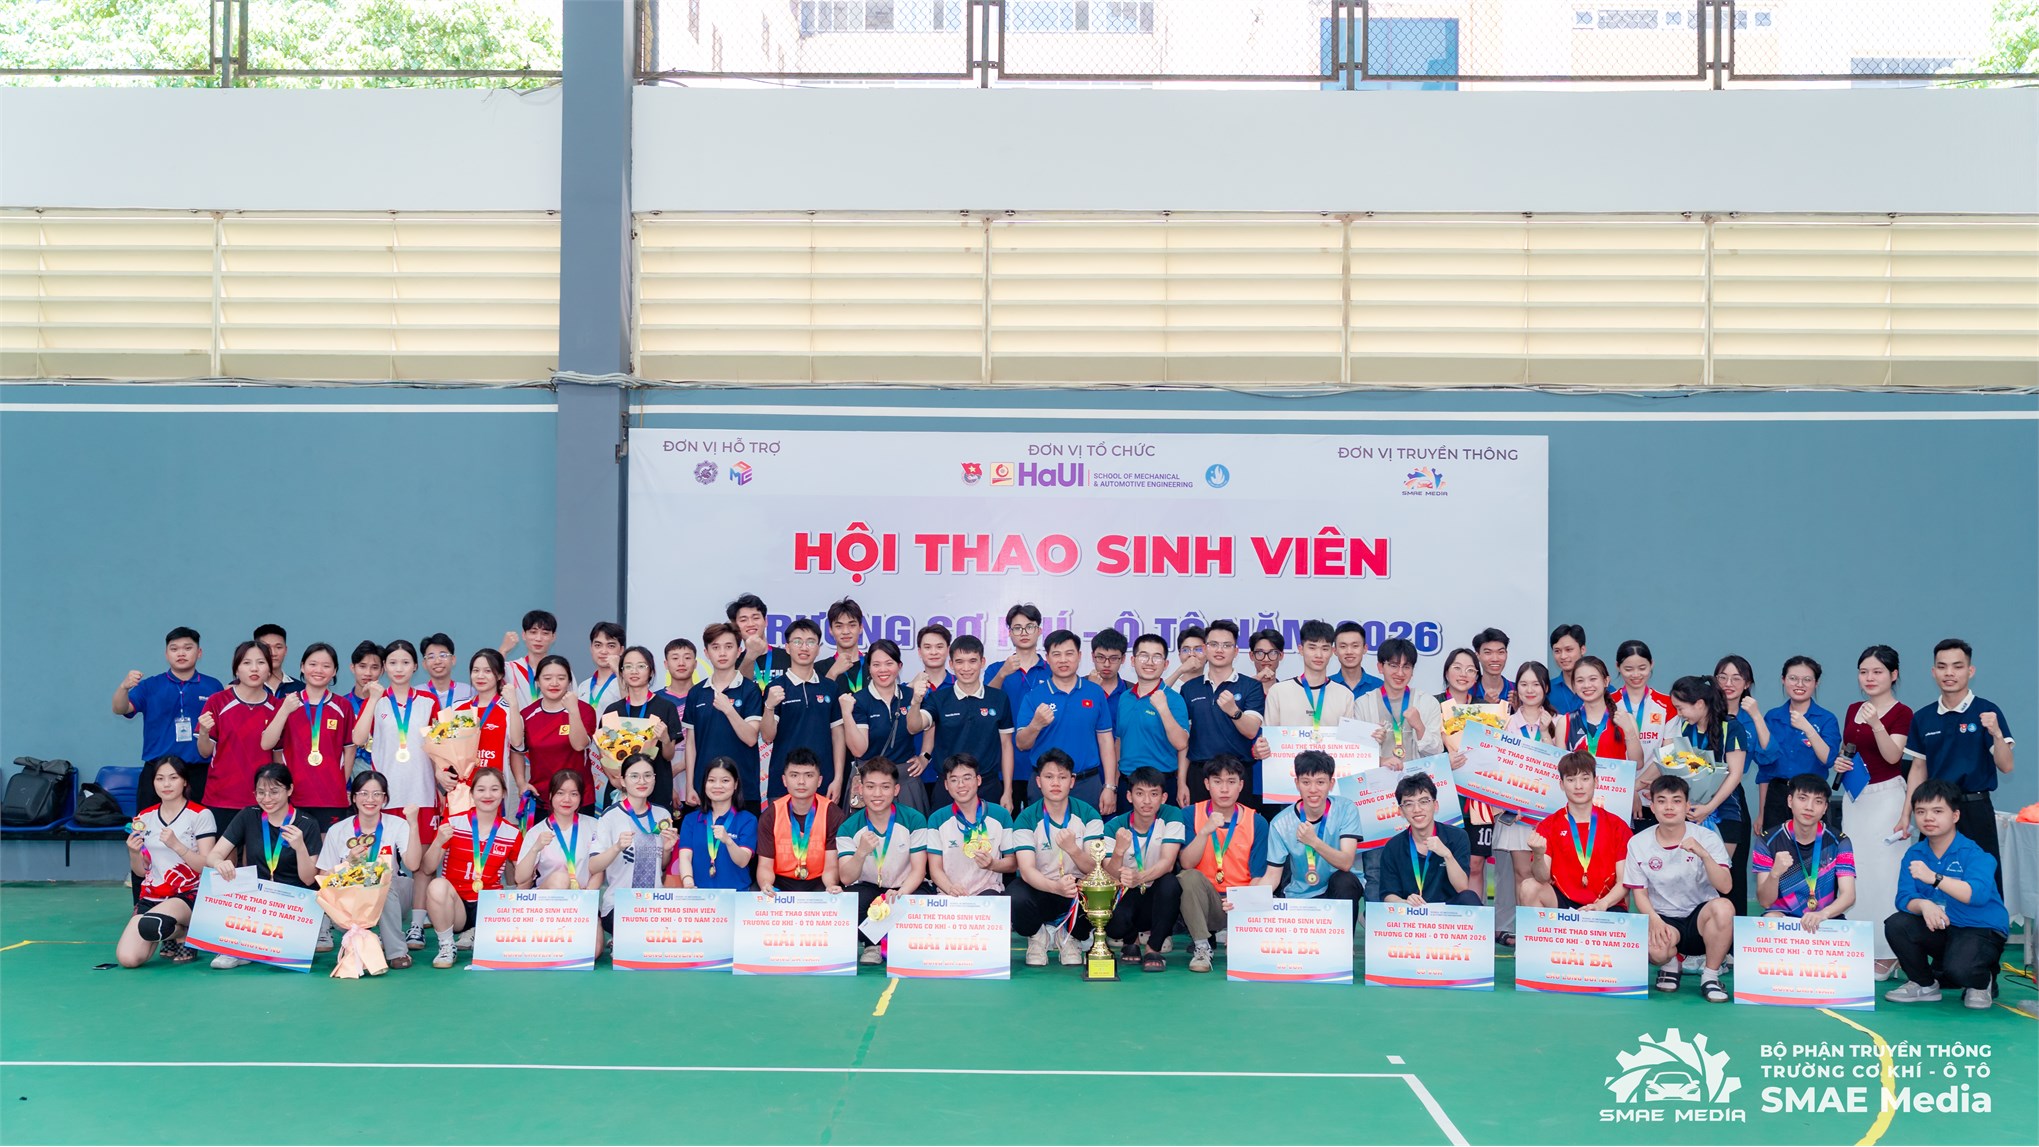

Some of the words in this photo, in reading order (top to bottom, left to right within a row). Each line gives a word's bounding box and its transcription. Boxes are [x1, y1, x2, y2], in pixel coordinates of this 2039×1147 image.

[663, 439, 698, 452] ĐƠN
[702, 442, 716, 455] VỊ
[722, 438, 745, 453] HỖ
[750, 441, 780, 456] TRỢ
[1028, 443, 1063, 456] ĐƠN
[1068, 445, 1082, 458] VỊ
[1087, 441, 1107, 456] TỔ
[1112, 443, 1155, 456] CHỨC
[1338, 446, 1373, 459] ĐƠN
[1378, 448, 1392, 461] VỊ
[1397, 445, 1458, 459] TRUYỀN
[1463, 447, 1518, 460] THÔNG
[1019, 463, 1084, 487] HaUI
[794, 520, 899, 584] HỘI
[914, 532, 1080, 575] THAO
[1096, 533, 1234, 576] SINH
[1250, 526, 1389, 577] VIÊN
[1337, 620, 1438, 652] 026
[1376, 802, 1400, 820] GIẢ
[1478, 828, 1492, 846] 10
[682, 930, 703, 943] BA
[1298, 941, 1319, 954] BA
[1590, 953, 1612, 967] BA
